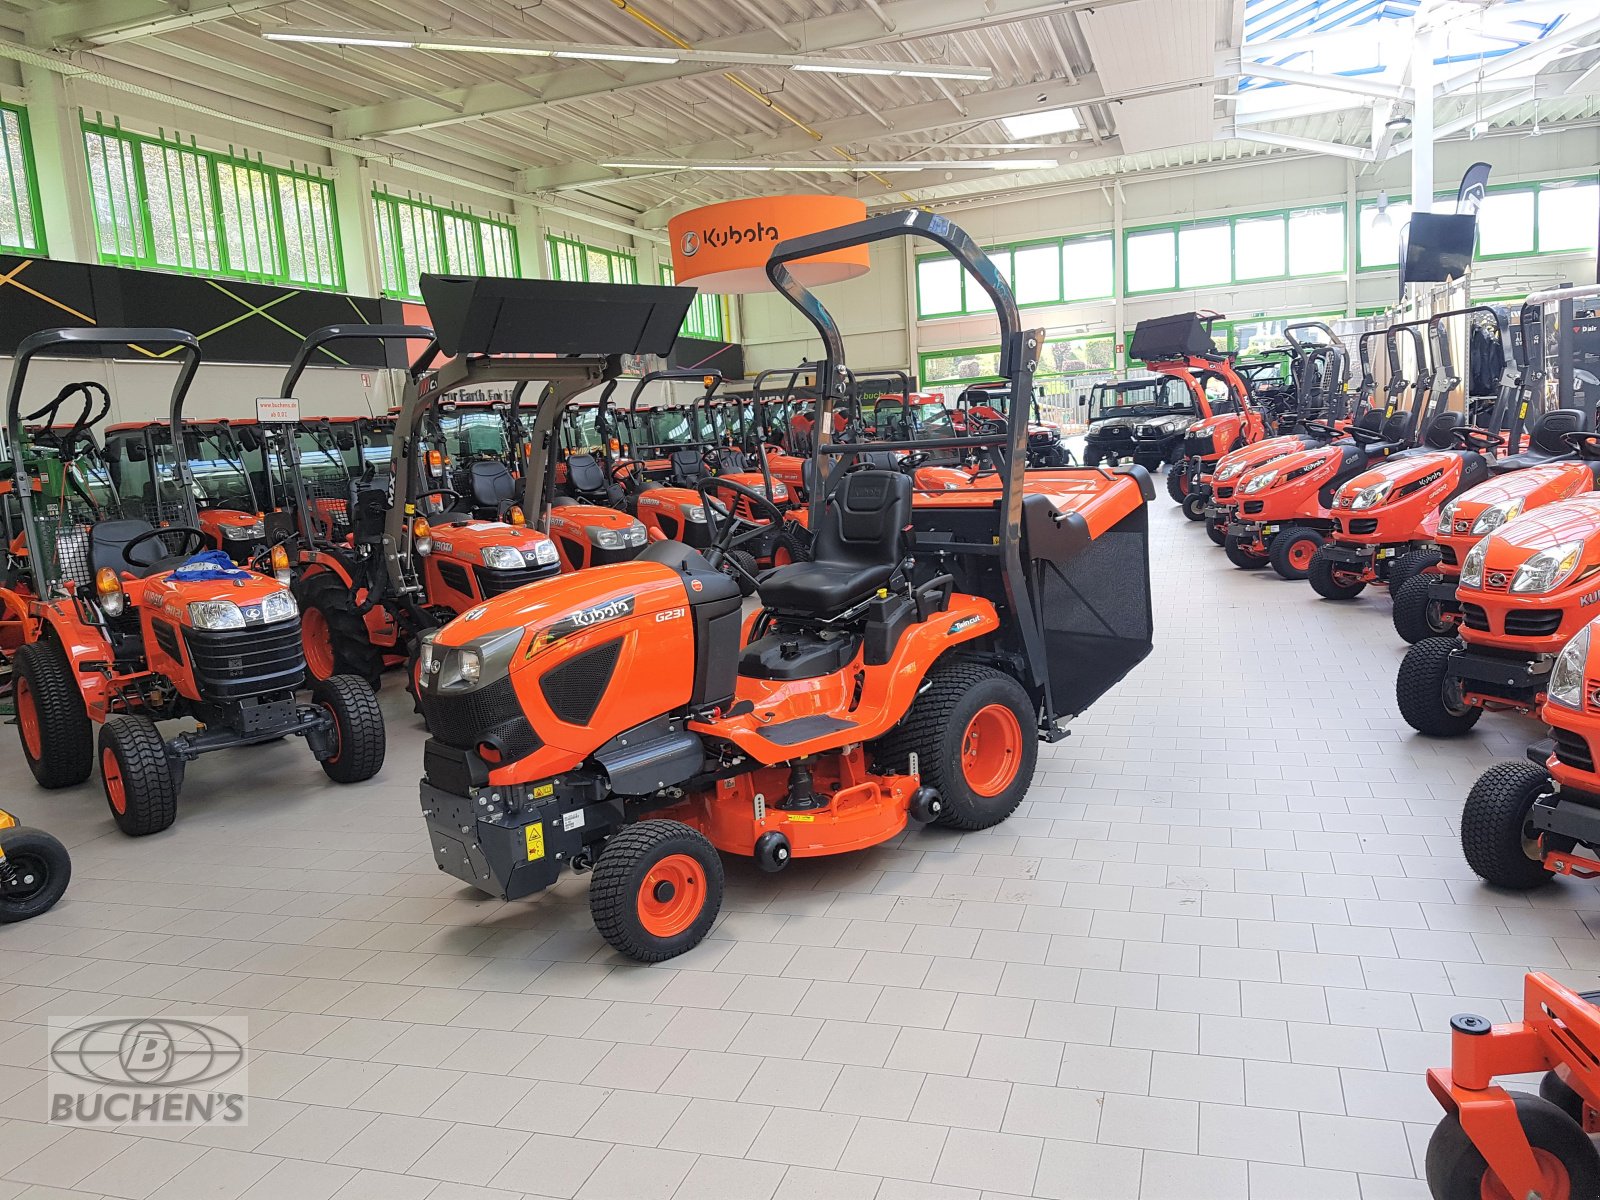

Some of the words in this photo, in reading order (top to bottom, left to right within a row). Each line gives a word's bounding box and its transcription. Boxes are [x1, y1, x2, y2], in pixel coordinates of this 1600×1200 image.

[703, 221, 779, 248] Kubota
[1303, 459, 1325, 472] Kubota
[1419, 471, 1442, 486] Kubota
[387, 471, 396, 507] MX
[1579, 589, 1600, 608] KU
[571, 600, 630, 626] Kubota
[655, 607, 686, 623] G231
